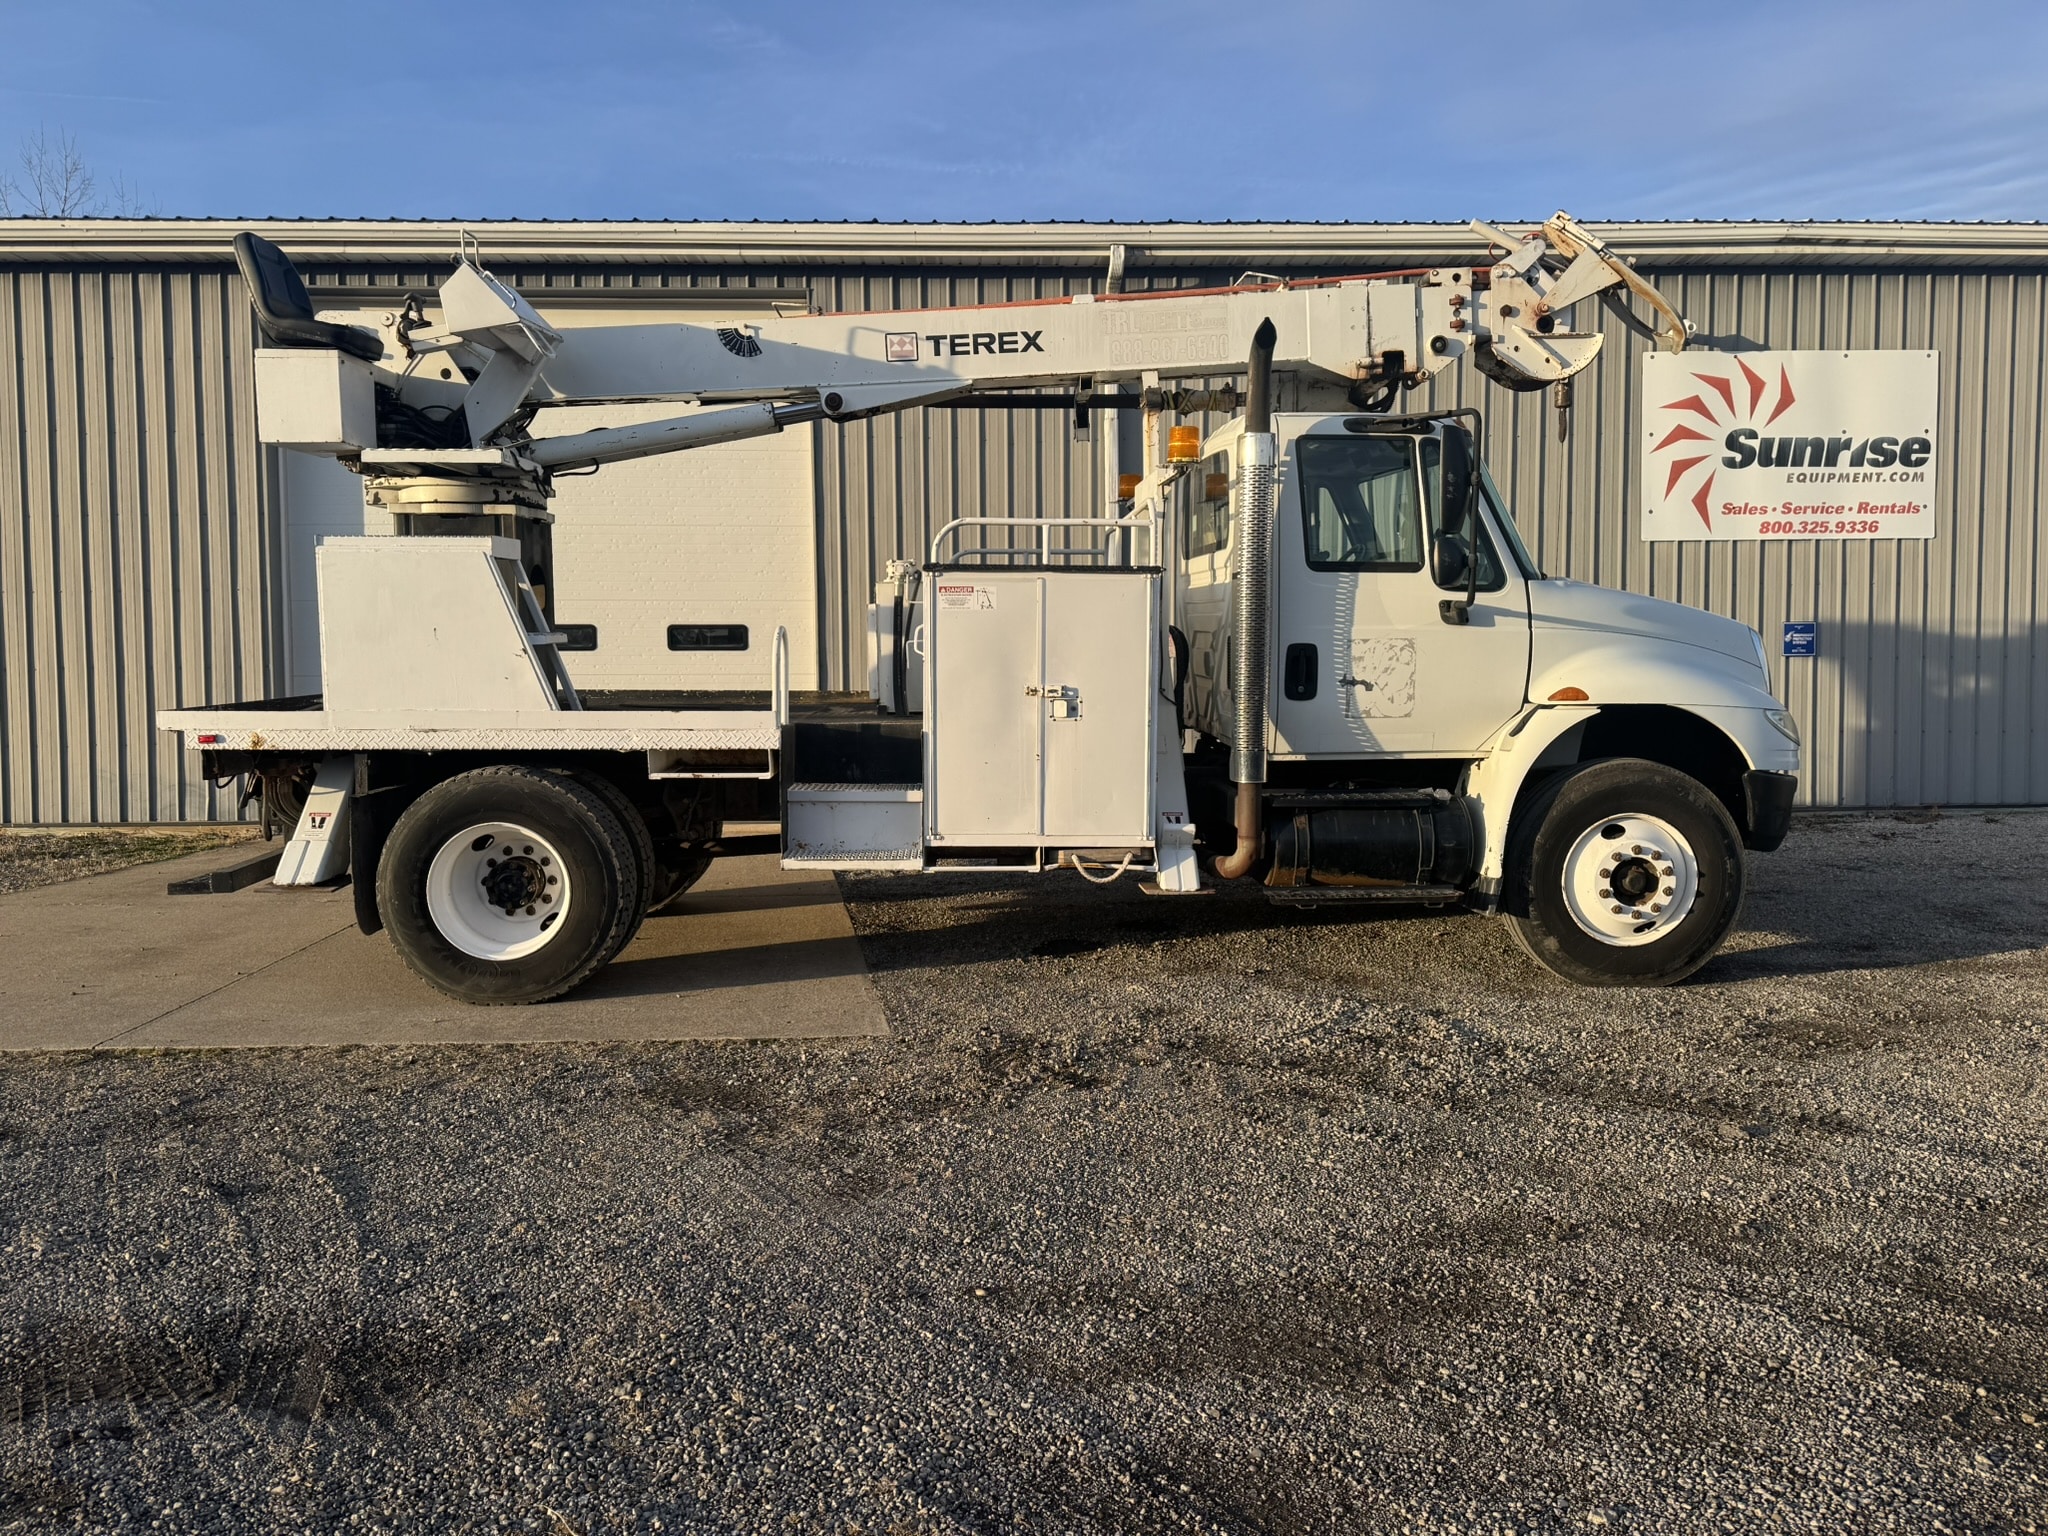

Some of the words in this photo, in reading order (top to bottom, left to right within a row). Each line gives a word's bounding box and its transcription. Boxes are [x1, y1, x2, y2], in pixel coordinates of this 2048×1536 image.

[925, 330, 1045, 357] TEREX
[1721, 427, 1931, 469] Sunrise
[1786, 471, 1925, 484] EQUIPMENT.COM
[1721, 502, 1768, 516] Sales
[1780, 501, 1845, 515] Service
[1856, 501, 1921, 515] Rentals
[1758, 520, 1880, 535] 800.325.9336
